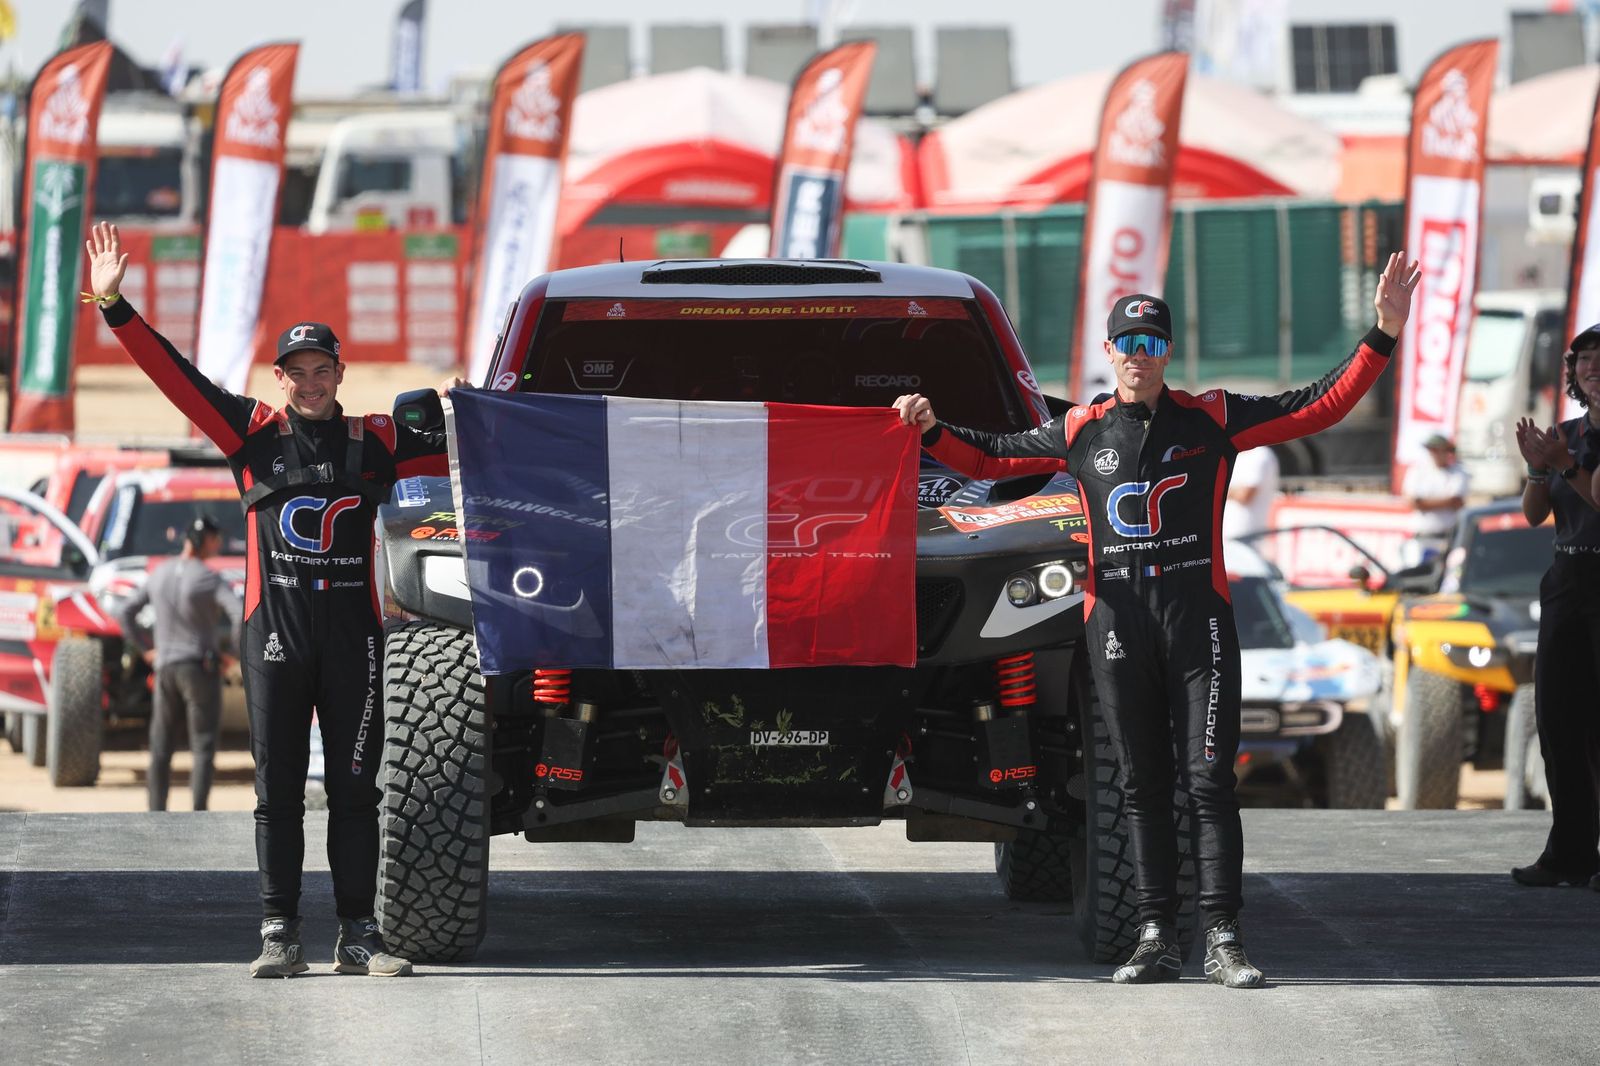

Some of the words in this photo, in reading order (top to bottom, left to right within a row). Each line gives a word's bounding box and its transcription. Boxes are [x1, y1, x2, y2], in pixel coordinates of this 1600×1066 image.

[680, 307, 745, 315] DREAM.
[747, 307, 796, 315] DARE.
[800, 306, 832, 314] LIVE
[583, 363, 614, 374] OMP
[855, 375, 921, 388] RECARO
[1026, 497, 1079, 509] 2026
[959, 513, 988, 522] 214
[1019, 505, 1072, 518] ARABIA
[1103, 542, 1161, 555] FACTORY
[1163, 534, 1198, 547] TEAM
[271, 550, 330, 566] FACTORY
[331, 556, 363, 565] TEAM
[1163, 563, 1180, 573] MATT
[1208, 617, 1222, 665] TEAM
[353, 686, 376, 762] FACTORY
[367, 636, 376, 683] TEAM
[1205, 668, 1222, 747] FACTORY
[752, 731, 828, 745] DV-296-DP
[549, 767, 584, 781] R53
[1004, 765, 1037, 780] R53
